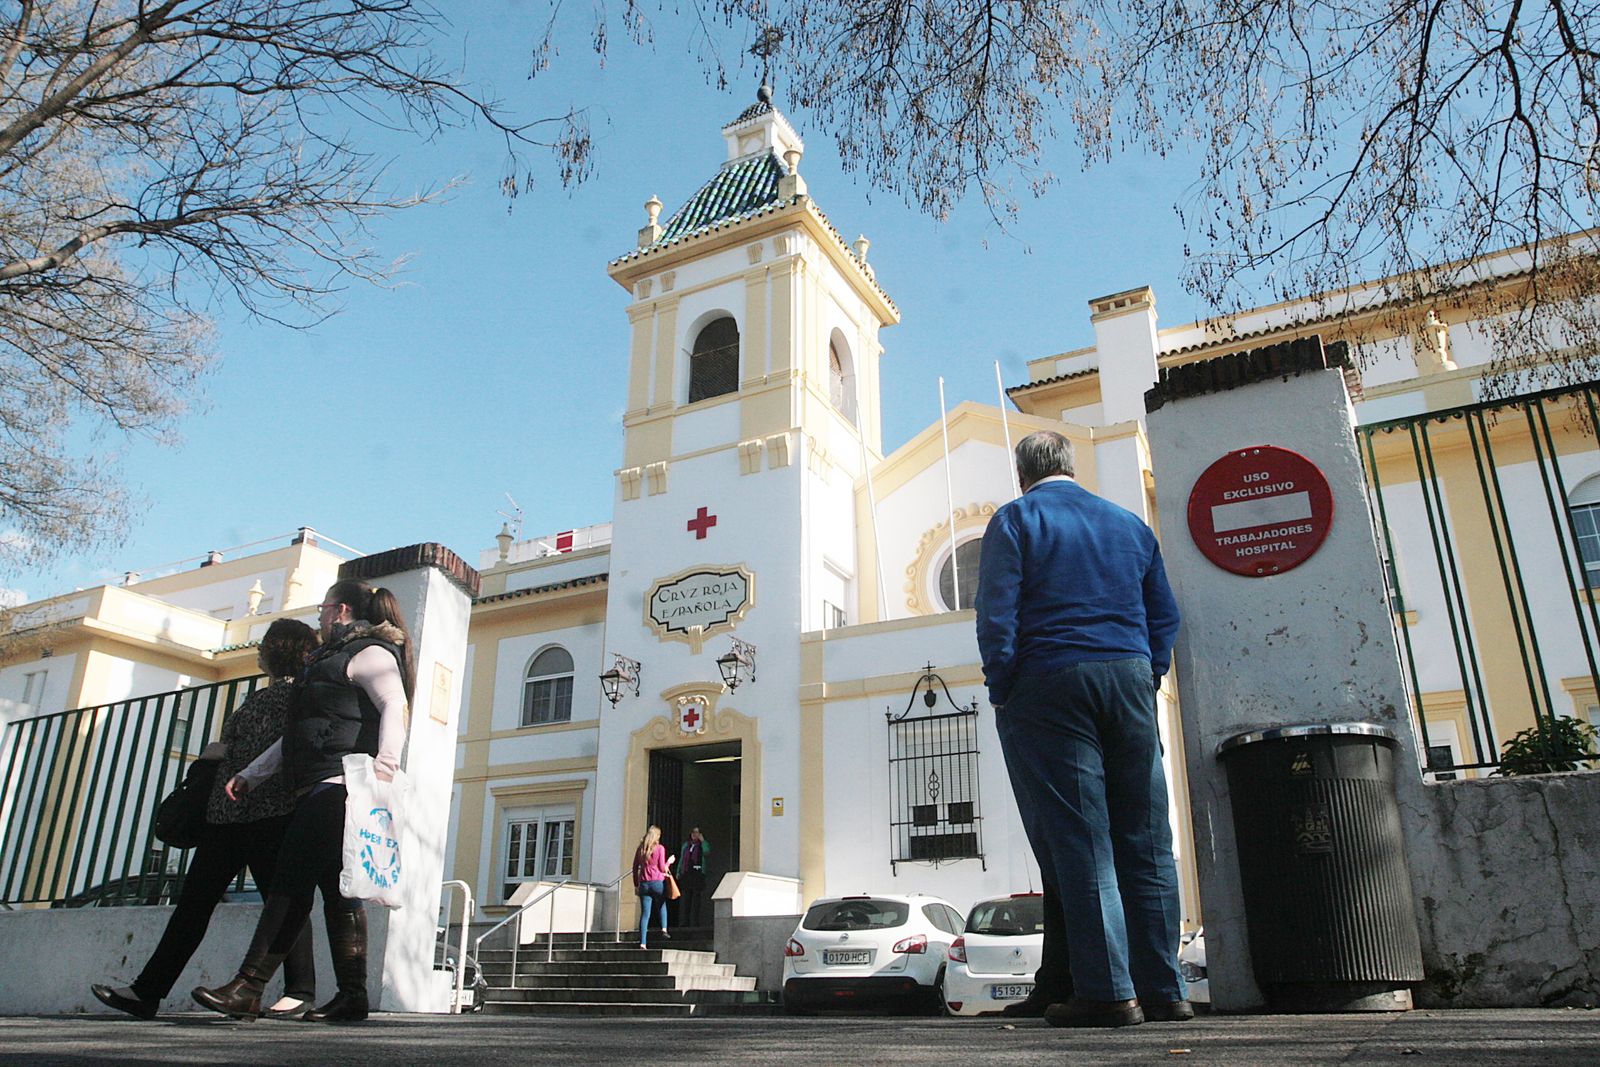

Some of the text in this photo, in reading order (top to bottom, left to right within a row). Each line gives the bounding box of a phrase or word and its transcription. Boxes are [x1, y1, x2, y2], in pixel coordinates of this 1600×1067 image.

[1243, 471, 1270, 483] USO
[1223, 481, 1294, 500] EXCLUSIVO
[1215, 524, 1313, 546] TRABAJADORES
[1235, 541, 1297, 557] HOSPITAL
[703, 582, 738, 596] ROJA
[662, 599, 732, 619] ESPAÑOLA
[829, 952, 850, 962] 0170
[997, 986, 1021, 996] 5192
